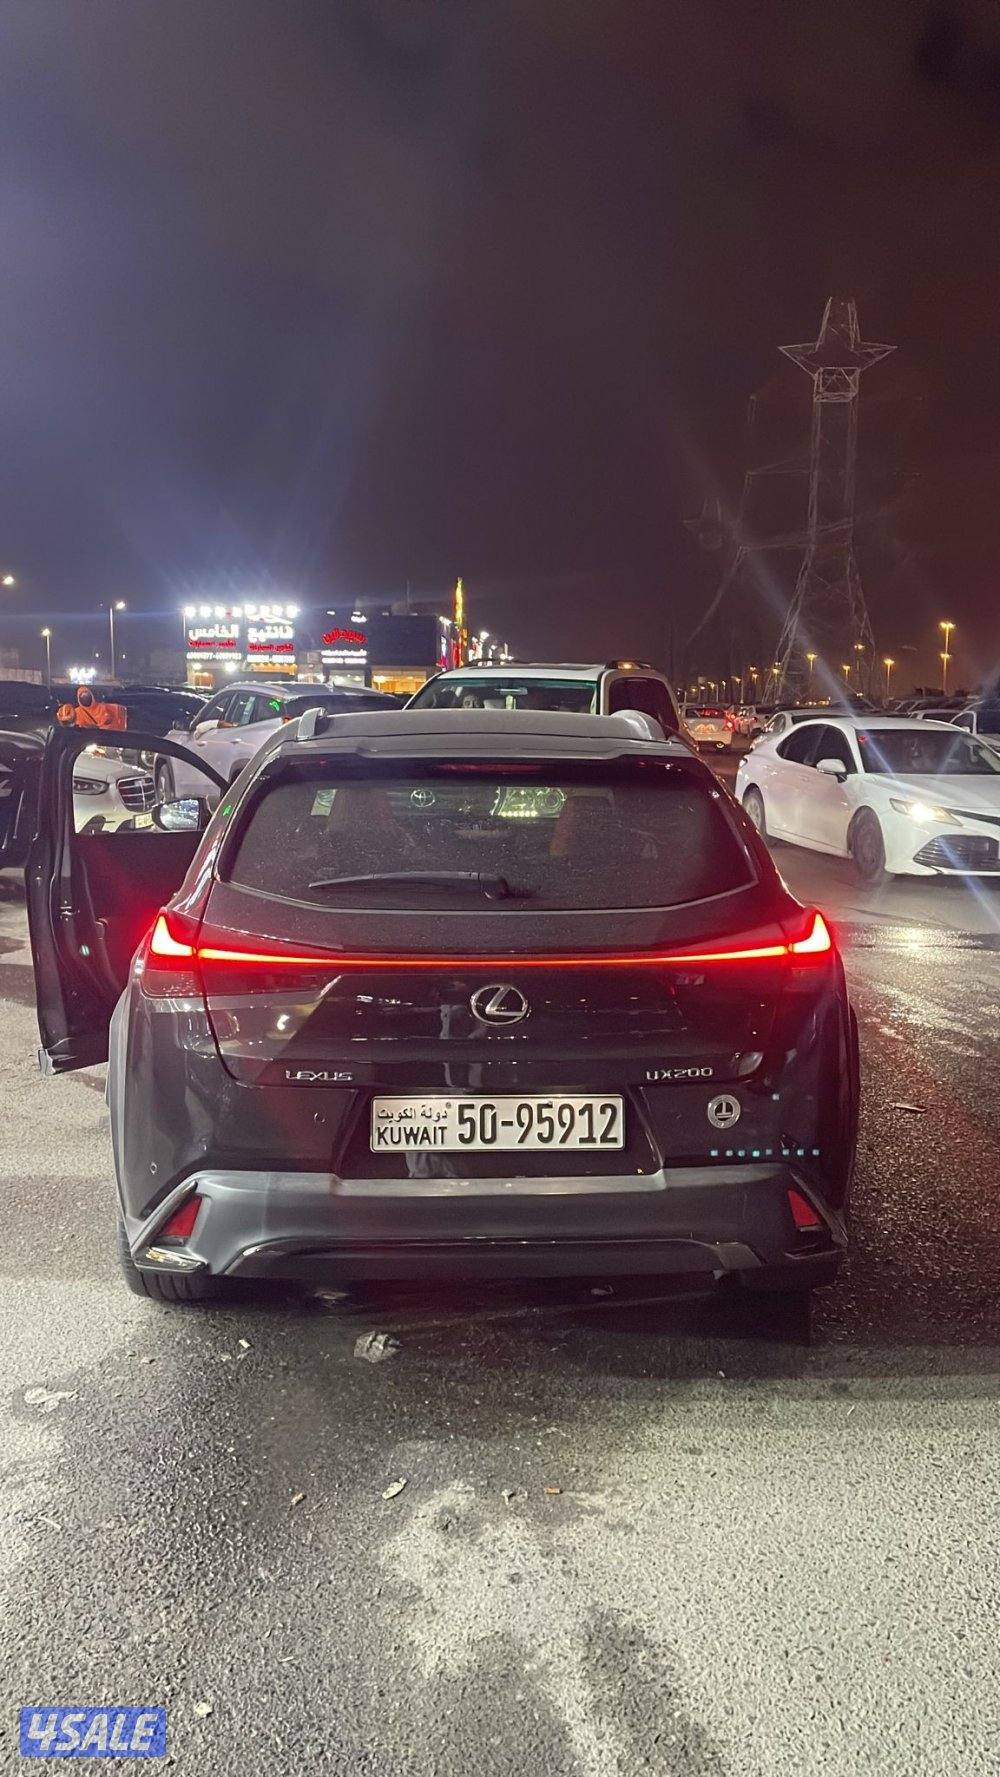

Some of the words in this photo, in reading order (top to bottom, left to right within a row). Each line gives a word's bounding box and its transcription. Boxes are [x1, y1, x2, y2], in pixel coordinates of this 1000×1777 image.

[285, 1070, 352, 1081] LEXUS
[646, 1067, 713, 1080] UX200
[377, 1107, 417, 1123] الكويت
[420, 1104, 449, 1123] دولة
[457, 1102, 618, 1145] 50-95912
[377, 1126, 448, 1146] KUWAIT
